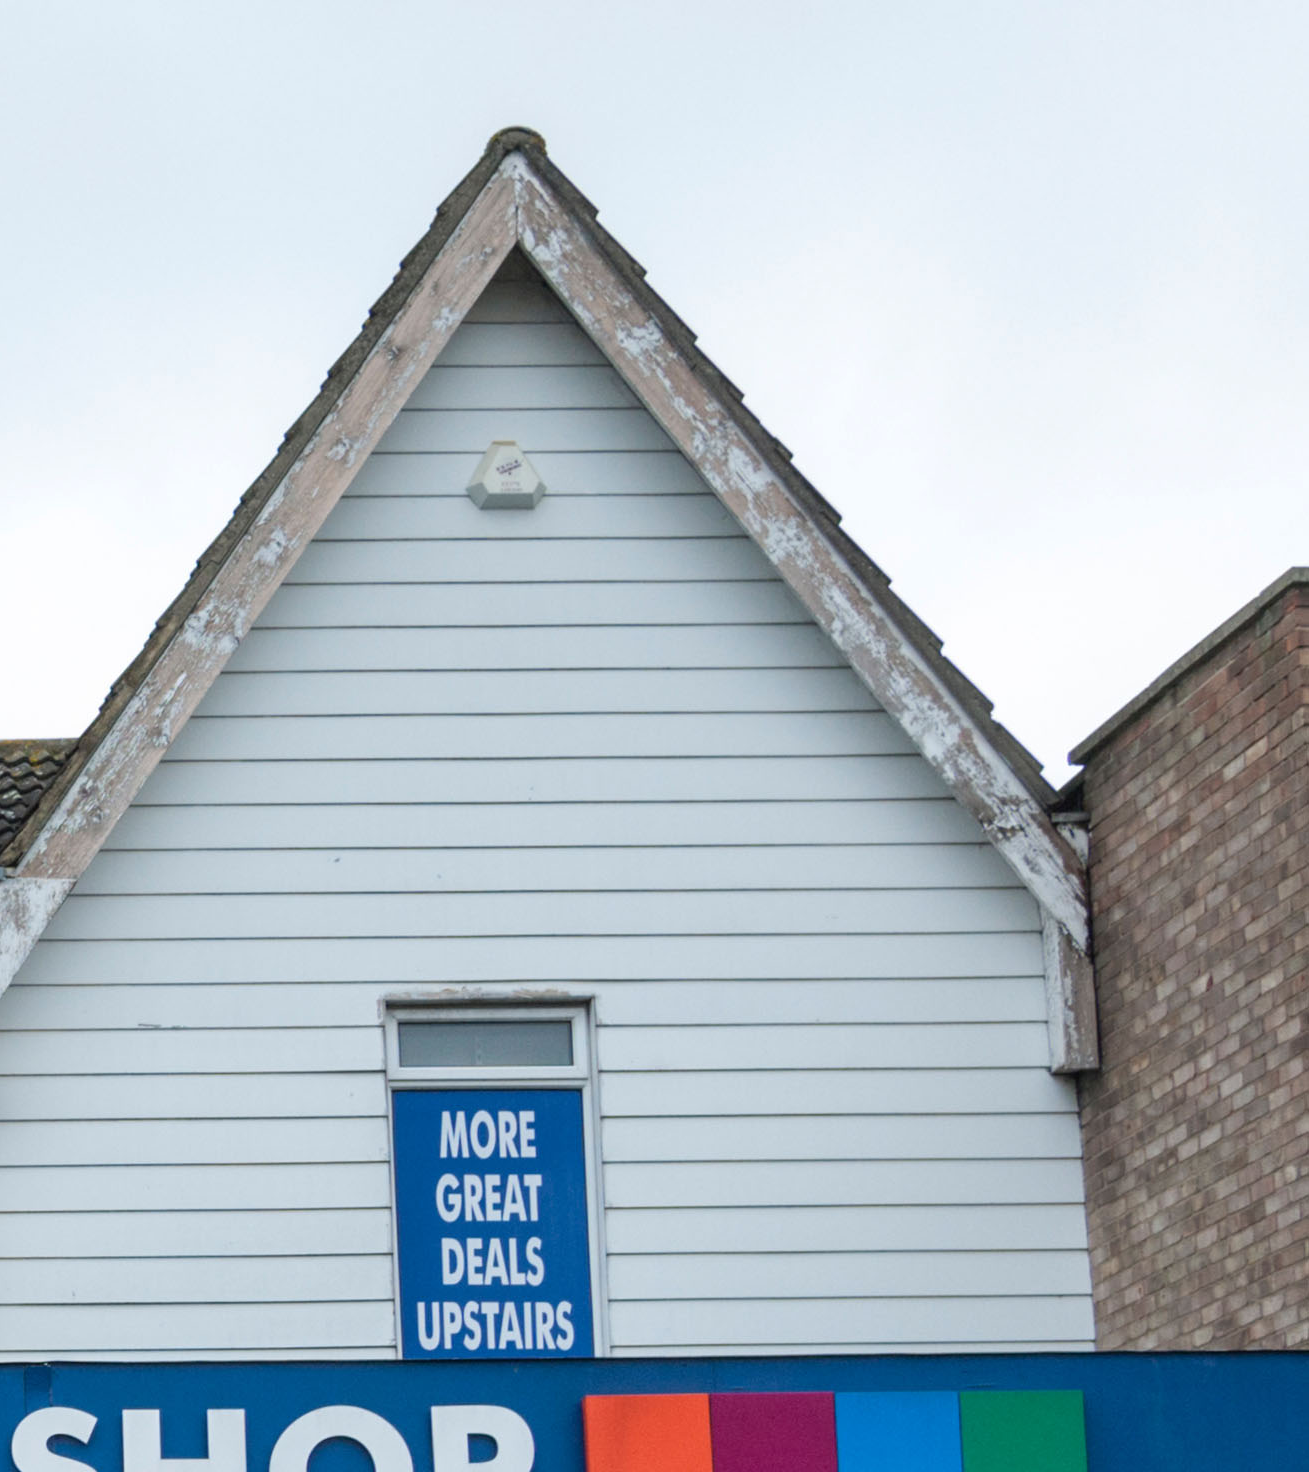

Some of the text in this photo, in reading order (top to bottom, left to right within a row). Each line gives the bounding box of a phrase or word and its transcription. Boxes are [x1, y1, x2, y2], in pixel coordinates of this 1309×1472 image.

[439, 1110, 537, 1159] MORE
[436, 1173, 542, 1223] GREAT
[441, 1236, 545, 1286] DEALS
[417, 1300, 575, 1351] UPSTAIRS
